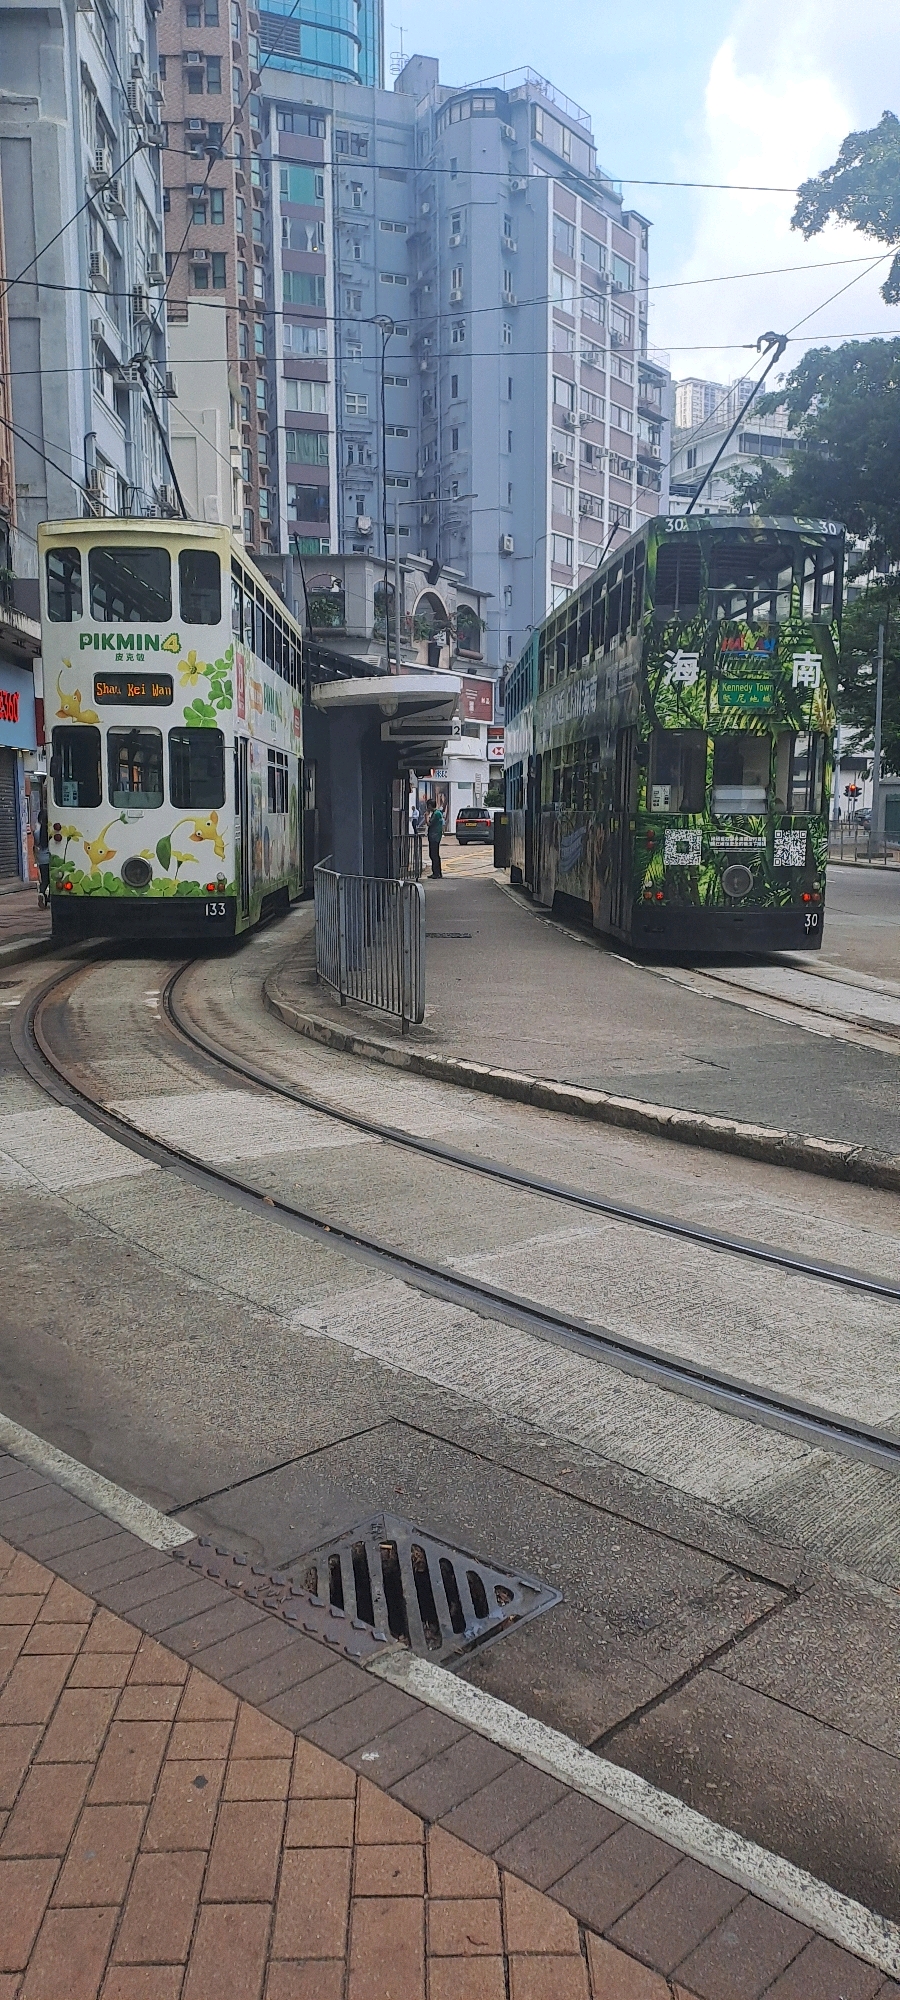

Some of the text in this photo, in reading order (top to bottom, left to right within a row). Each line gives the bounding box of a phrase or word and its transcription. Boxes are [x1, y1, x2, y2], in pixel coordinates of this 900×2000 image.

[665, 518, 684, 532] 30
[819, 521, 837, 535] 30
[663, 648, 700, 687] 海
[792, 651, 823, 688] 南
[127, 683, 146, 697] Kei
[151, 683, 172, 697] Wan
[722, 682, 753, 693] Kennedy
[453, 725, 461, 736] 2
[205, 902, 226, 916] 133
[804, 913, 818, 927] 30
